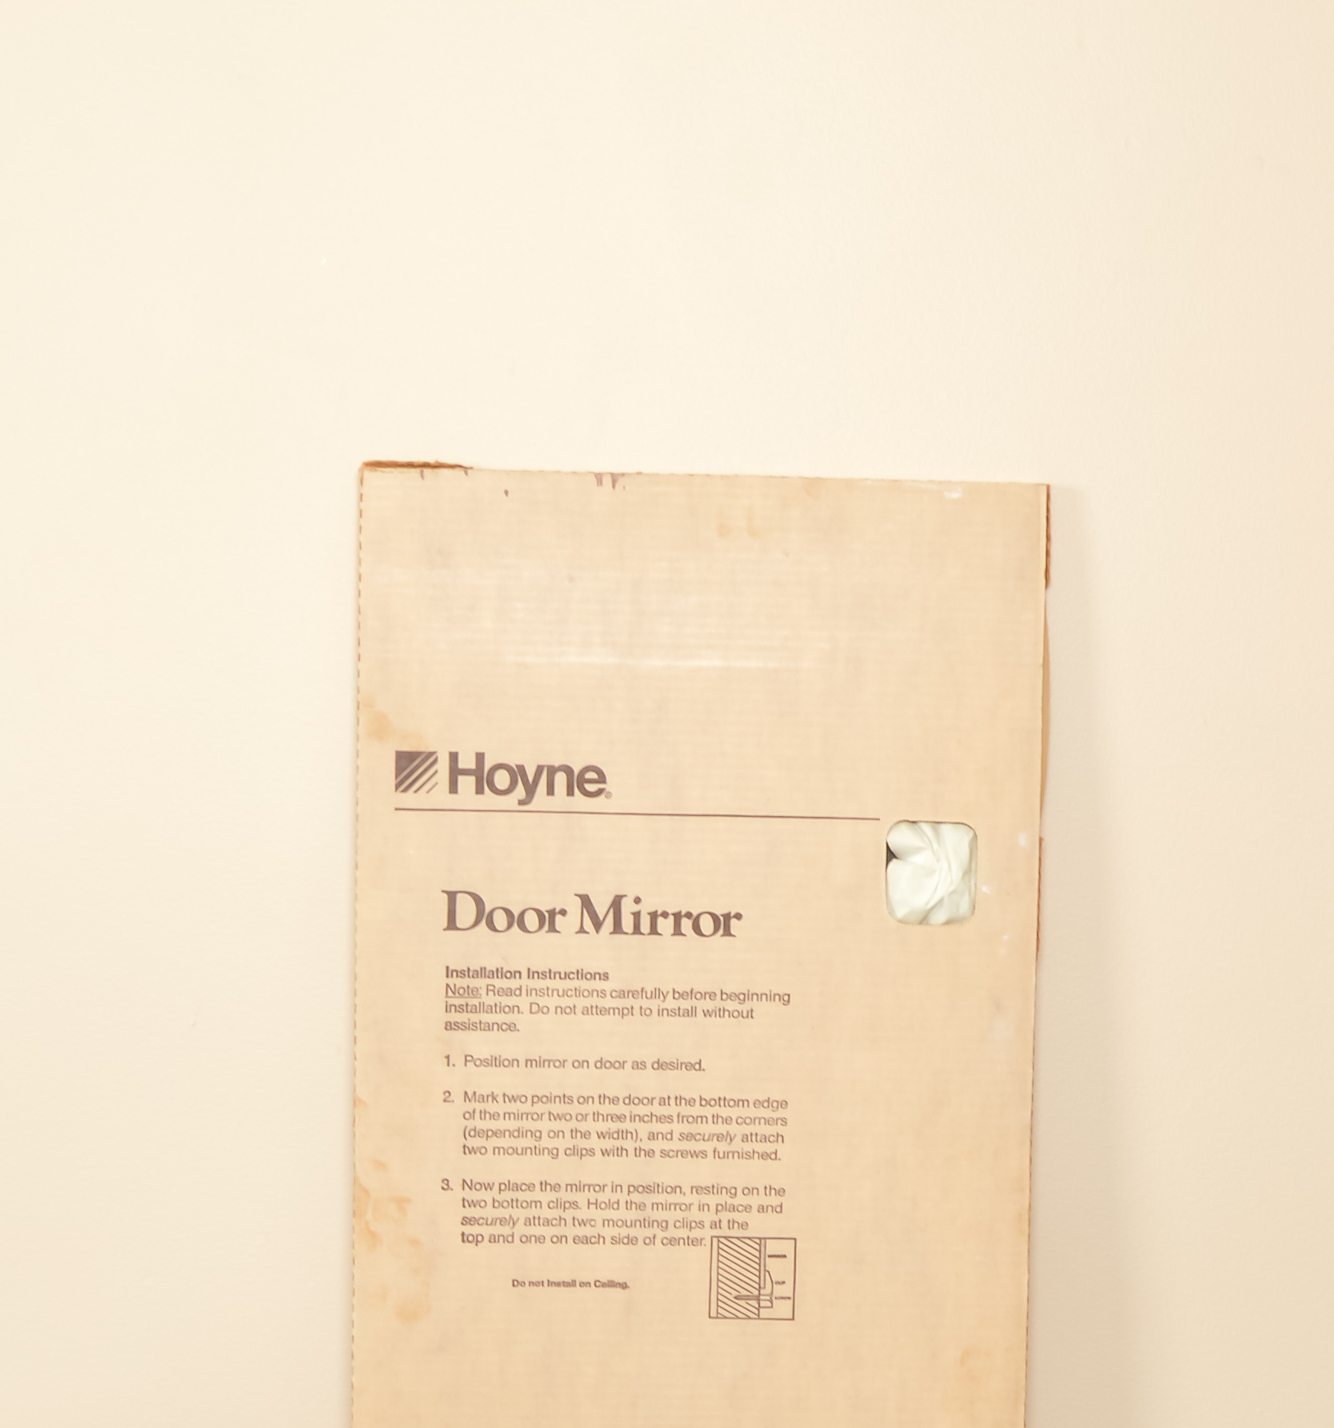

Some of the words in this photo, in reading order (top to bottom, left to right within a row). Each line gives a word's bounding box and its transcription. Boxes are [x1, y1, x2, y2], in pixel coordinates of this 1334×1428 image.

[440, 889, 568, 935] Door
[573, 893, 744, 938] Mirror
[445, 965, 523, 980] Installation
[526, 967, 610, 982] Instructions
[444, 983, 482, 1000] Note:
[485, 984, 523, 998] Read
[525, 984, 607, 1000] instructions
[609, 986, 670, 1003] carefully
[671, 987, 717, 1002] before
[719, 988, 791, 1006] beginning
[444, 1000, 524, 1015] installation.
[529, 1002, 551, 1016] Do
[554, 1003, 577, 1016] not
[580, 1003, 635, 1020] attempt
[638, 1005, 653, 1018] to
[656, 1004, 698, 1018] install
[701, 1005, 755, 1020] without
[443, 1018, 520, 1033] assistance.
[443, 1055, 456, 1068] 1.
[463, 1055, 520, 1069] Position
[524, 1056, 568, 1069] mirror
[571, 1058, 590, 1070] on
[593, 1056, 628, 1071] door
[630, 1060, 648, 1071] as
[650, 1057, 706, 1072] desired.
[442, 1090, 455, 1104] 2.
[463, 1090, 500, 1104] Mark
[501, 1092, 528, 1105] two
[530, 1091, 574, 1108] points
[576, 1094, 595, 1106] on
[598, 1093, 620, 1106] the
[622, 1093, 657, 1107] door
[658, 1094, 672, 1107] at
[673, 1094, 696, 1108] the
[698, 1095, 750, 1109] bottom
[753, 1097, 789, 1112] edge
[462, 1108, 477, 1122] of
[478, 1108, 501, 1122] the
[502, 1109, 546, 1122] mirror
[547, 1110, 573, 1123] two
[574, 1112, 590, 1123] or
[591, 1110, 627, 1124] three
[628, 1110, 674, 1125] inches
[676, 1112, 709, 1125] from
[711, 1112, 733, 1126] the
[734, 1115, 788, 1127] corners
[462, 1125, 543, 1142] (depending
[547, 1129, 566, 1140] on
[569, 1127, 592, 1141] the
[595, 1127, 643, 1143] width),
[646, 1129, 674, 1142] and
[677, 1130, 737, 1144] securely
[740, 1131, 785, 1144] attach
[462, 1144, 488, 1156] two
[492, 1144, 560, 1160] mounting
[564, 1144, 596, 1161] clips
[600, 1145, 629, 1158] with
[633, 1145, 656, 1159] the
[659, 1148, 709, 1160] screws
[712, 1146, 782, 1162] furnished.
[440, 1178, 454, 1192] 3.
[461, 1178, 495, 1192] Now
[498, 1179, 536, 1195] place
[539, 1180, 562, 1193] the
[564, 1180, 608, 1194] mirror
[610, 1181, 624, 1194] in
[626, 1181, 687, 1197] position,
[690, 1183, 738, 1199] resting
[741, 1186, 760, 1197] on
[763, 1184, 787, 1198] the
[461, 1197, 488, 1209] two
[491, 1197, 543, 1210] bottom
[546, 1197, 582, 1213] clips.
[586, 1197, 621, 1211] Hold
[624, 1199, 647, 1212] the
[650, 1199, 694, 1213] mirror
[697, 1200, 711, 1213] in
[714, 1201, 753, 1216] place
[756, 1202, 784, 1215] and
[460, 1214, 520, 1229] securely
[523, 1215, 568, 1228] attach
[571, 1216, 597, 1228] two
[601, 1216, 669, 1232] mounting
[672, 1217, 705, 1233] clips
[709, 1218, 723, 1230] at
[726, 1218, 749, 1231] the
[460, 1231, 485, 1246] top
[487, 1231, 515, 1245] and
[519, 1234, 546, 1245] one
[550, 1234, 569, 1245] on
[572, 1232, 606, 1246] each
[609, 1233, 639, 1247] side
[643, 1233, 657, 1247] of
[660, 1234, 707, 1247] center.
[511, 1278, 526, 1288] Do
[527, 1280, 545, 1288] not
[546, 1279, 577, 1288] Install
[578, 1281, 592, 1289] on
